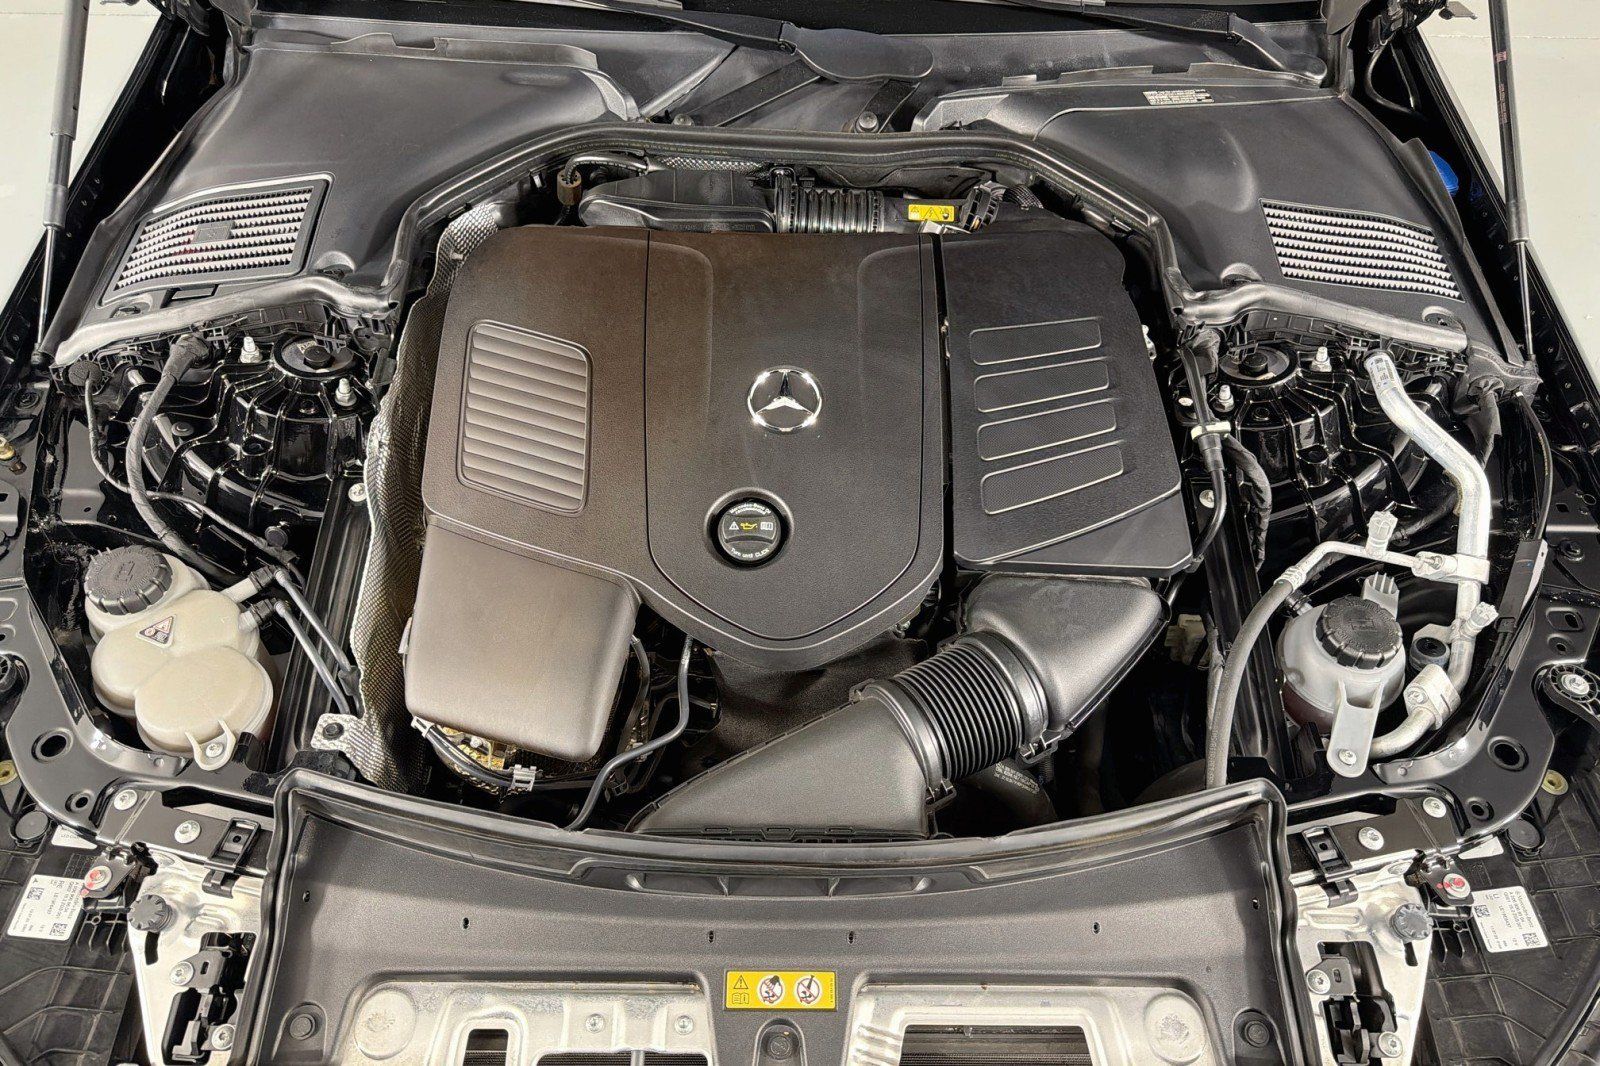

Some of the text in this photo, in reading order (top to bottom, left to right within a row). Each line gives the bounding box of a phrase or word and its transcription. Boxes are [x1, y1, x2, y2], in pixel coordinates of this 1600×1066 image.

[729, 503, 766, 514] Mercedes-Benz
[731, 548, 741, 556] Turn
[755, 548, 770, 558] CLICK
